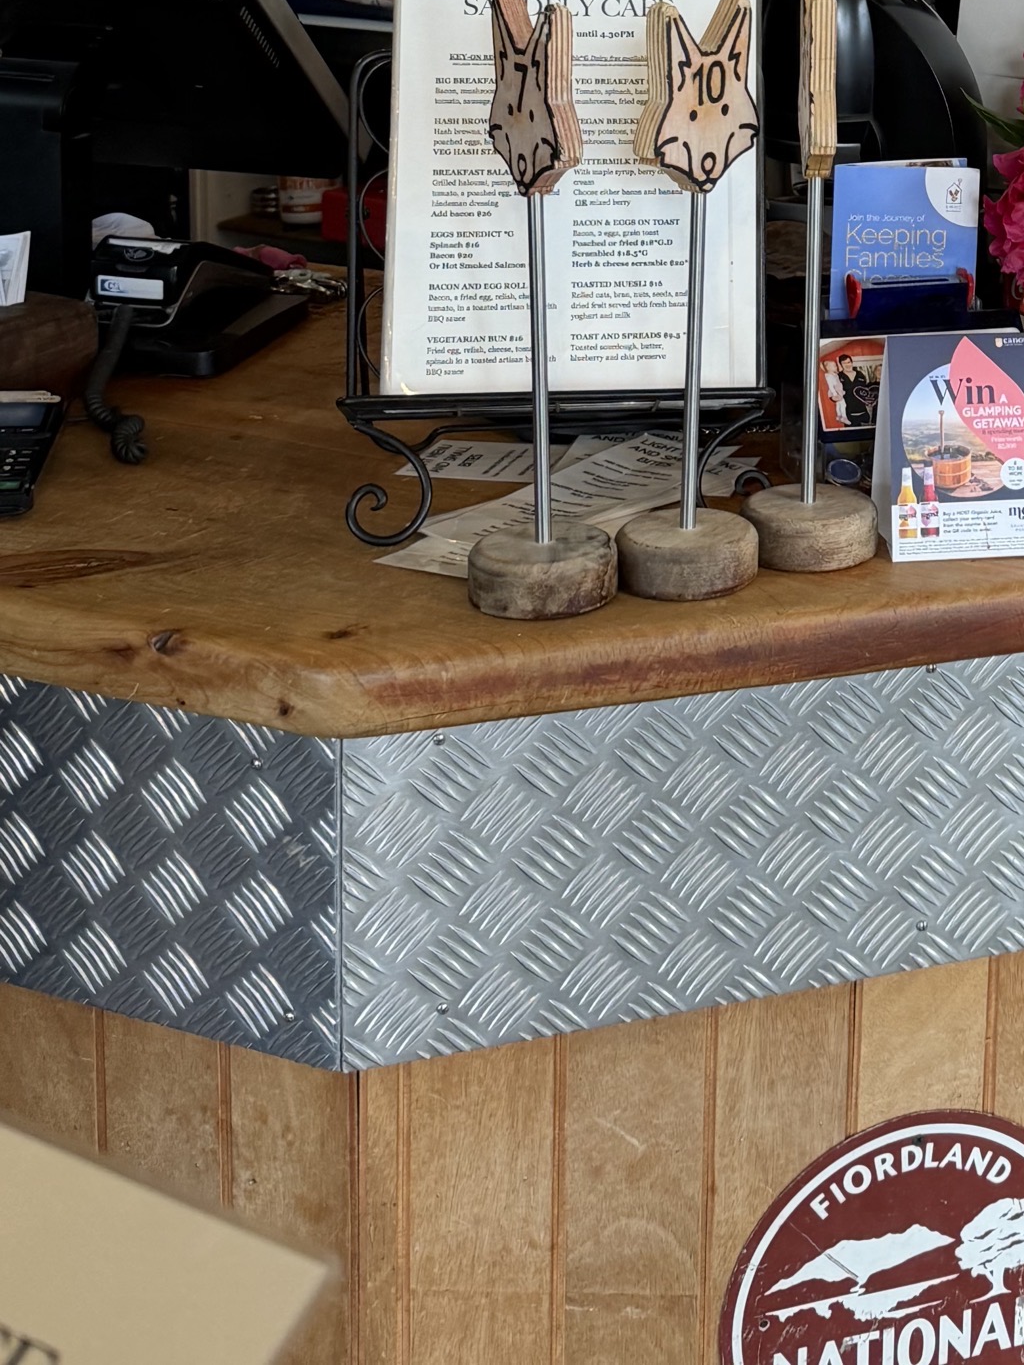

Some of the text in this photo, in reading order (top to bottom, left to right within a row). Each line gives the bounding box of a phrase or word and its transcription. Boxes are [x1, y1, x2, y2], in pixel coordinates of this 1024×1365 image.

[576, 30, 598, 39] until
[435, 77, 452, 85] BIG
[575, 78, 645, 86] VEG BREAKFAST
[692, 60, 726, 107] 10
[513, 63, 528, 114] 7
[572, 219, 603, 227] BACON
[652, 218, 680, 226] TOAST
[848, 214, 926, 224] Join the Journey of
[456, 230, 502, 238] BENEDICT
[846, 221, 947, 251] Keeping
[429, 241, 463, 250] Spinach
[845, 244, 945, 268] Families
[495, 261, 526, 269] Salmon
[572, 260, 592, 268] Herb
[428, 283, 460, 291] BACON
[427, 335, 507, 344] VEGETARIAN BUN
[929, 377, 1008, 406] Win A
[962, 405, 1022, 418] GLAMPING
[809, 1142, 1012, 1221] FIORDLAND
